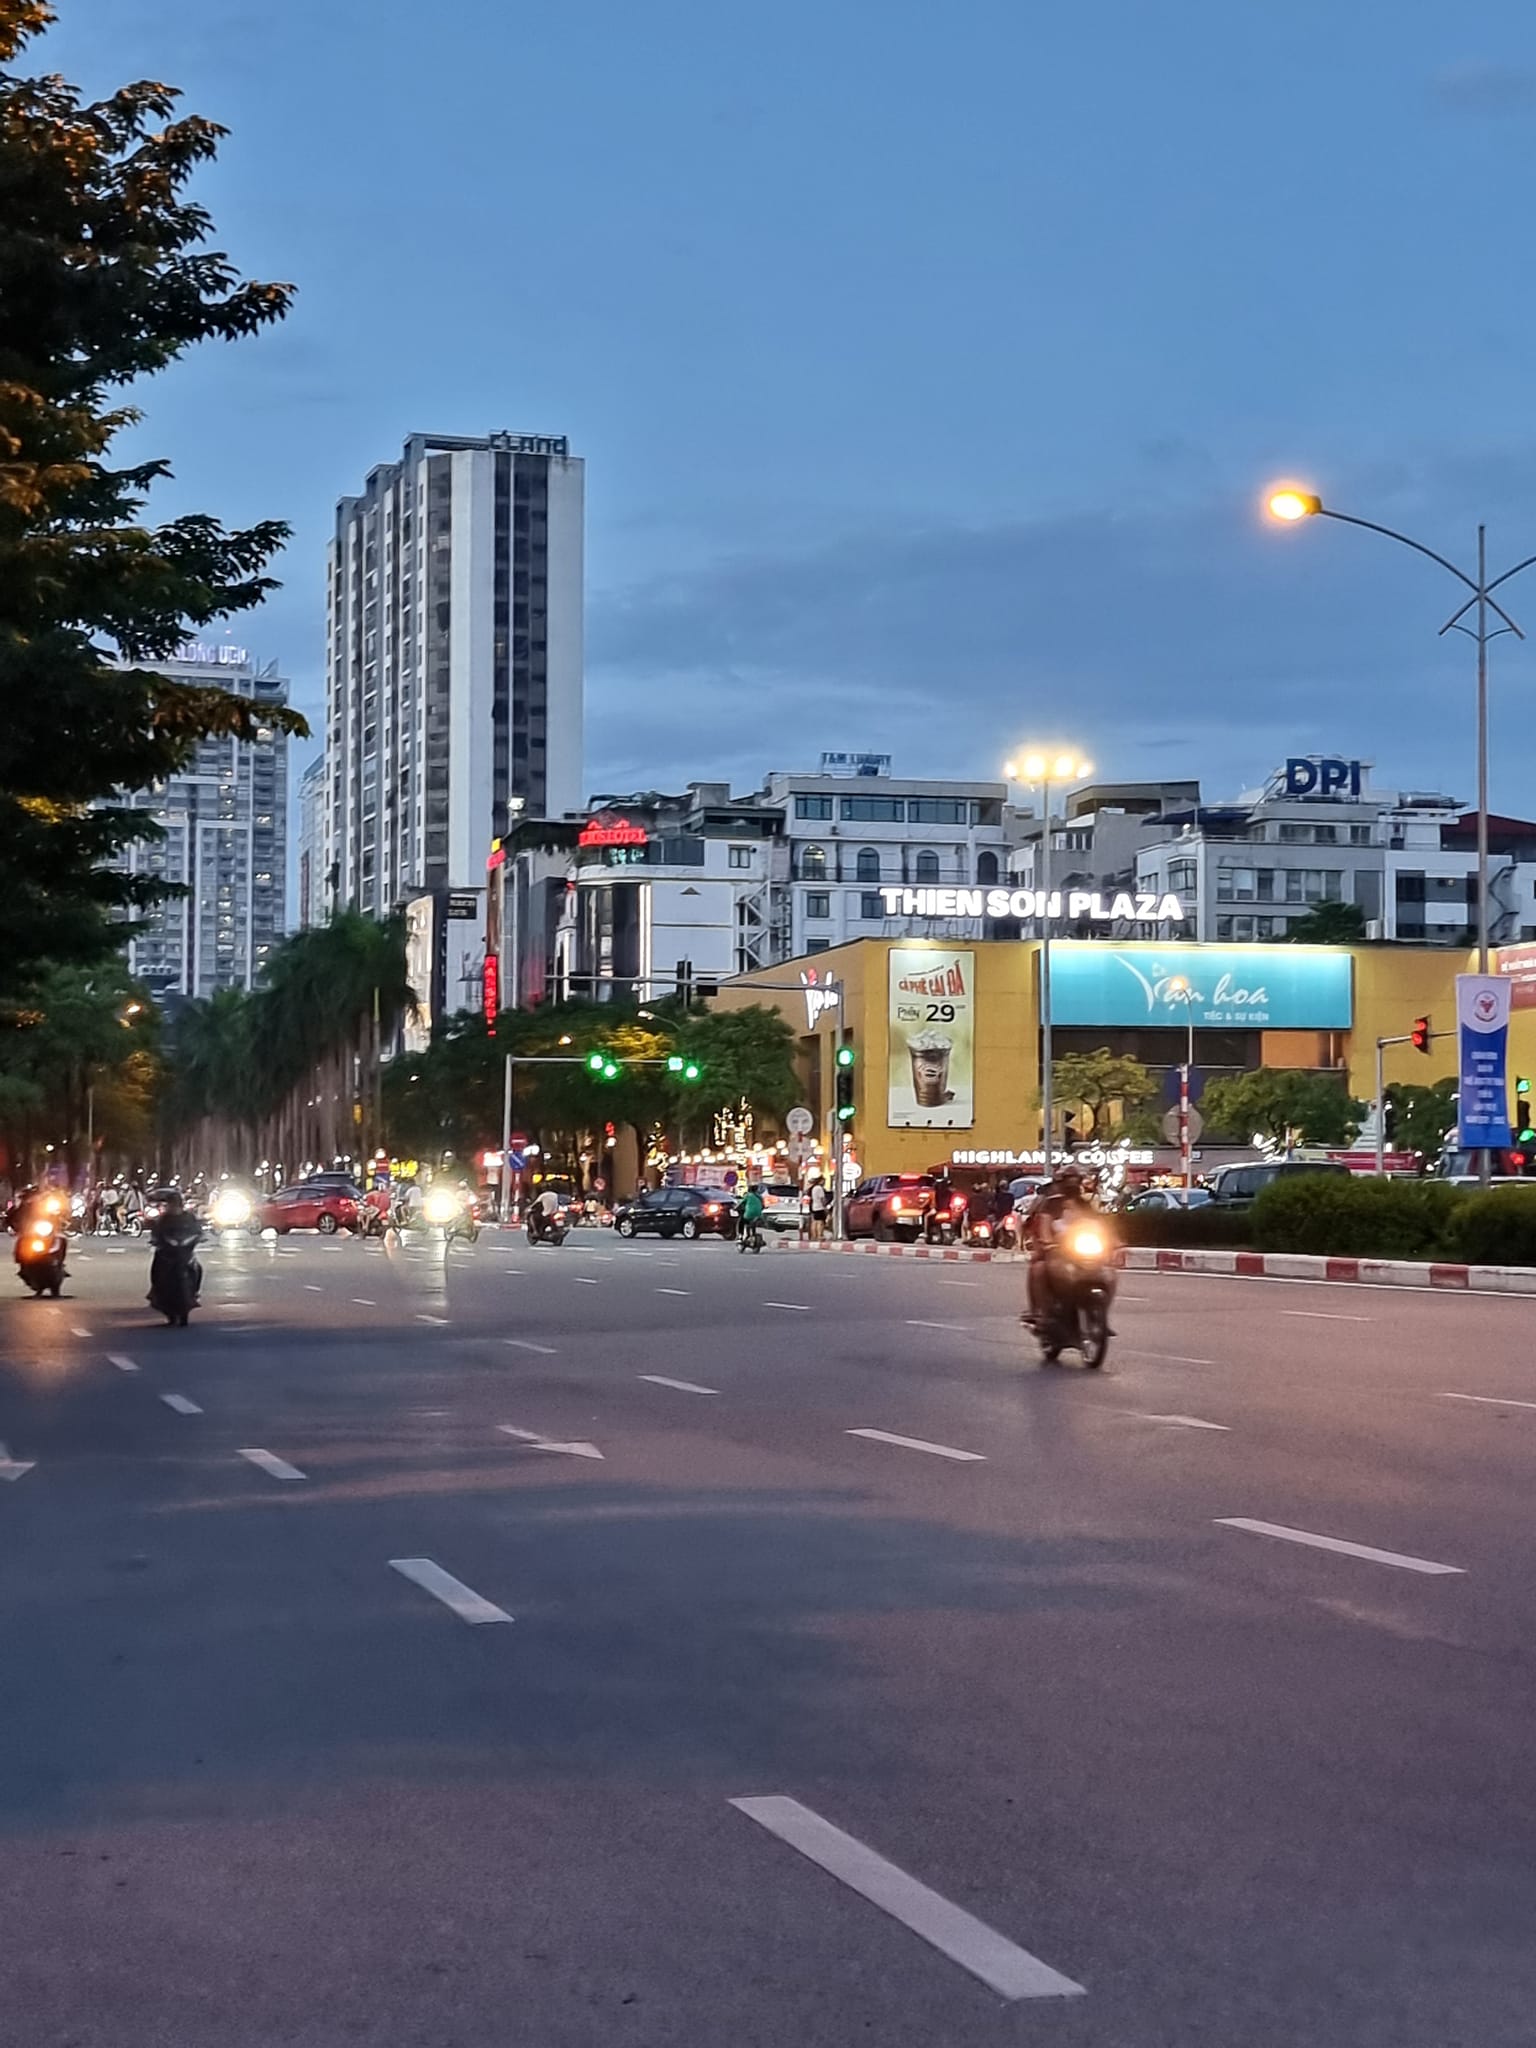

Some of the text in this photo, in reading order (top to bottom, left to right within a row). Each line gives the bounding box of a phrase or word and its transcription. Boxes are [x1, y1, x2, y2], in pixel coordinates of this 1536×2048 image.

[879, 888, 1183, 921] THIEN SON PLAZA
[1213, 973, 1270, 1006] hoa
[926, 1003, 955, 1023] 29
